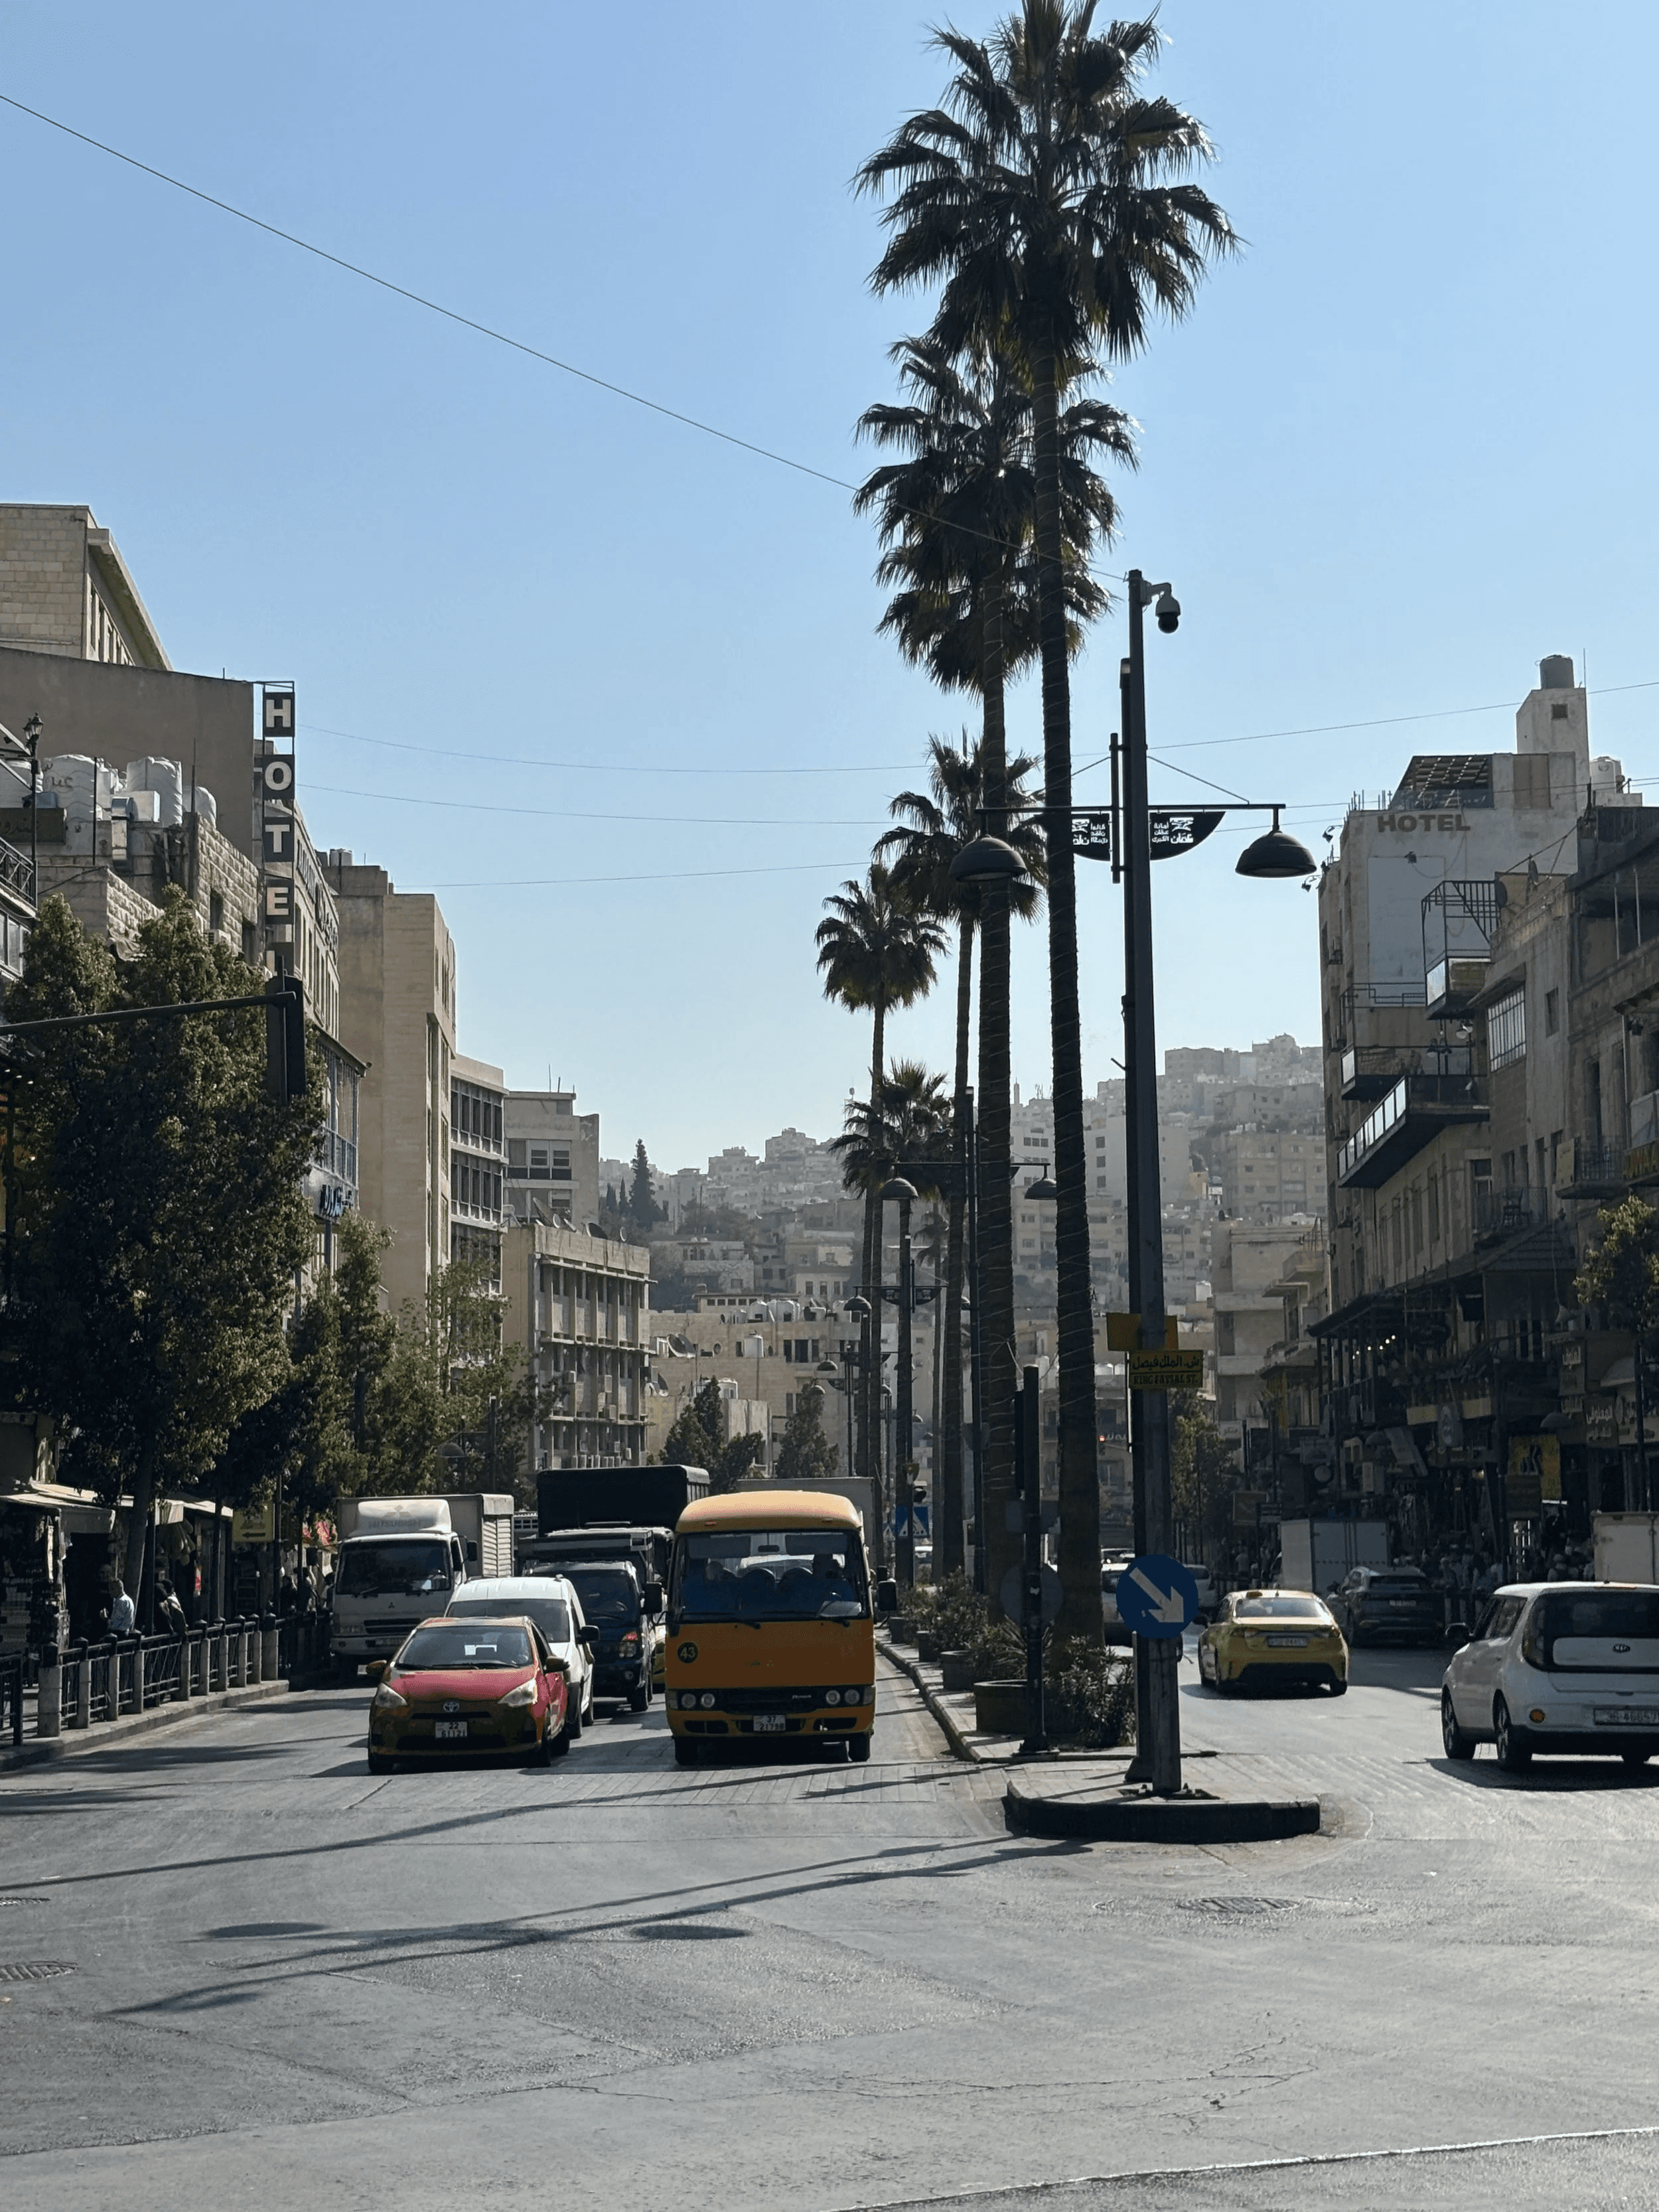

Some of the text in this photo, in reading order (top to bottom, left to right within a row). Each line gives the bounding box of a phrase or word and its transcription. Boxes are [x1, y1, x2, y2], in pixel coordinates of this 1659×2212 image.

[1377, 814, 1471, 833] HOTEL
[1132, 1355, 1159, 1370] فيصل
[1159, 1355, 1183, 1368] الملك
[1133, 1375, 1153, 1384] KING
[680, 1646, 695, 1659] 43
[449, 1720, 459, 1730] 22
[767, 1715, 776, 1724] 37
